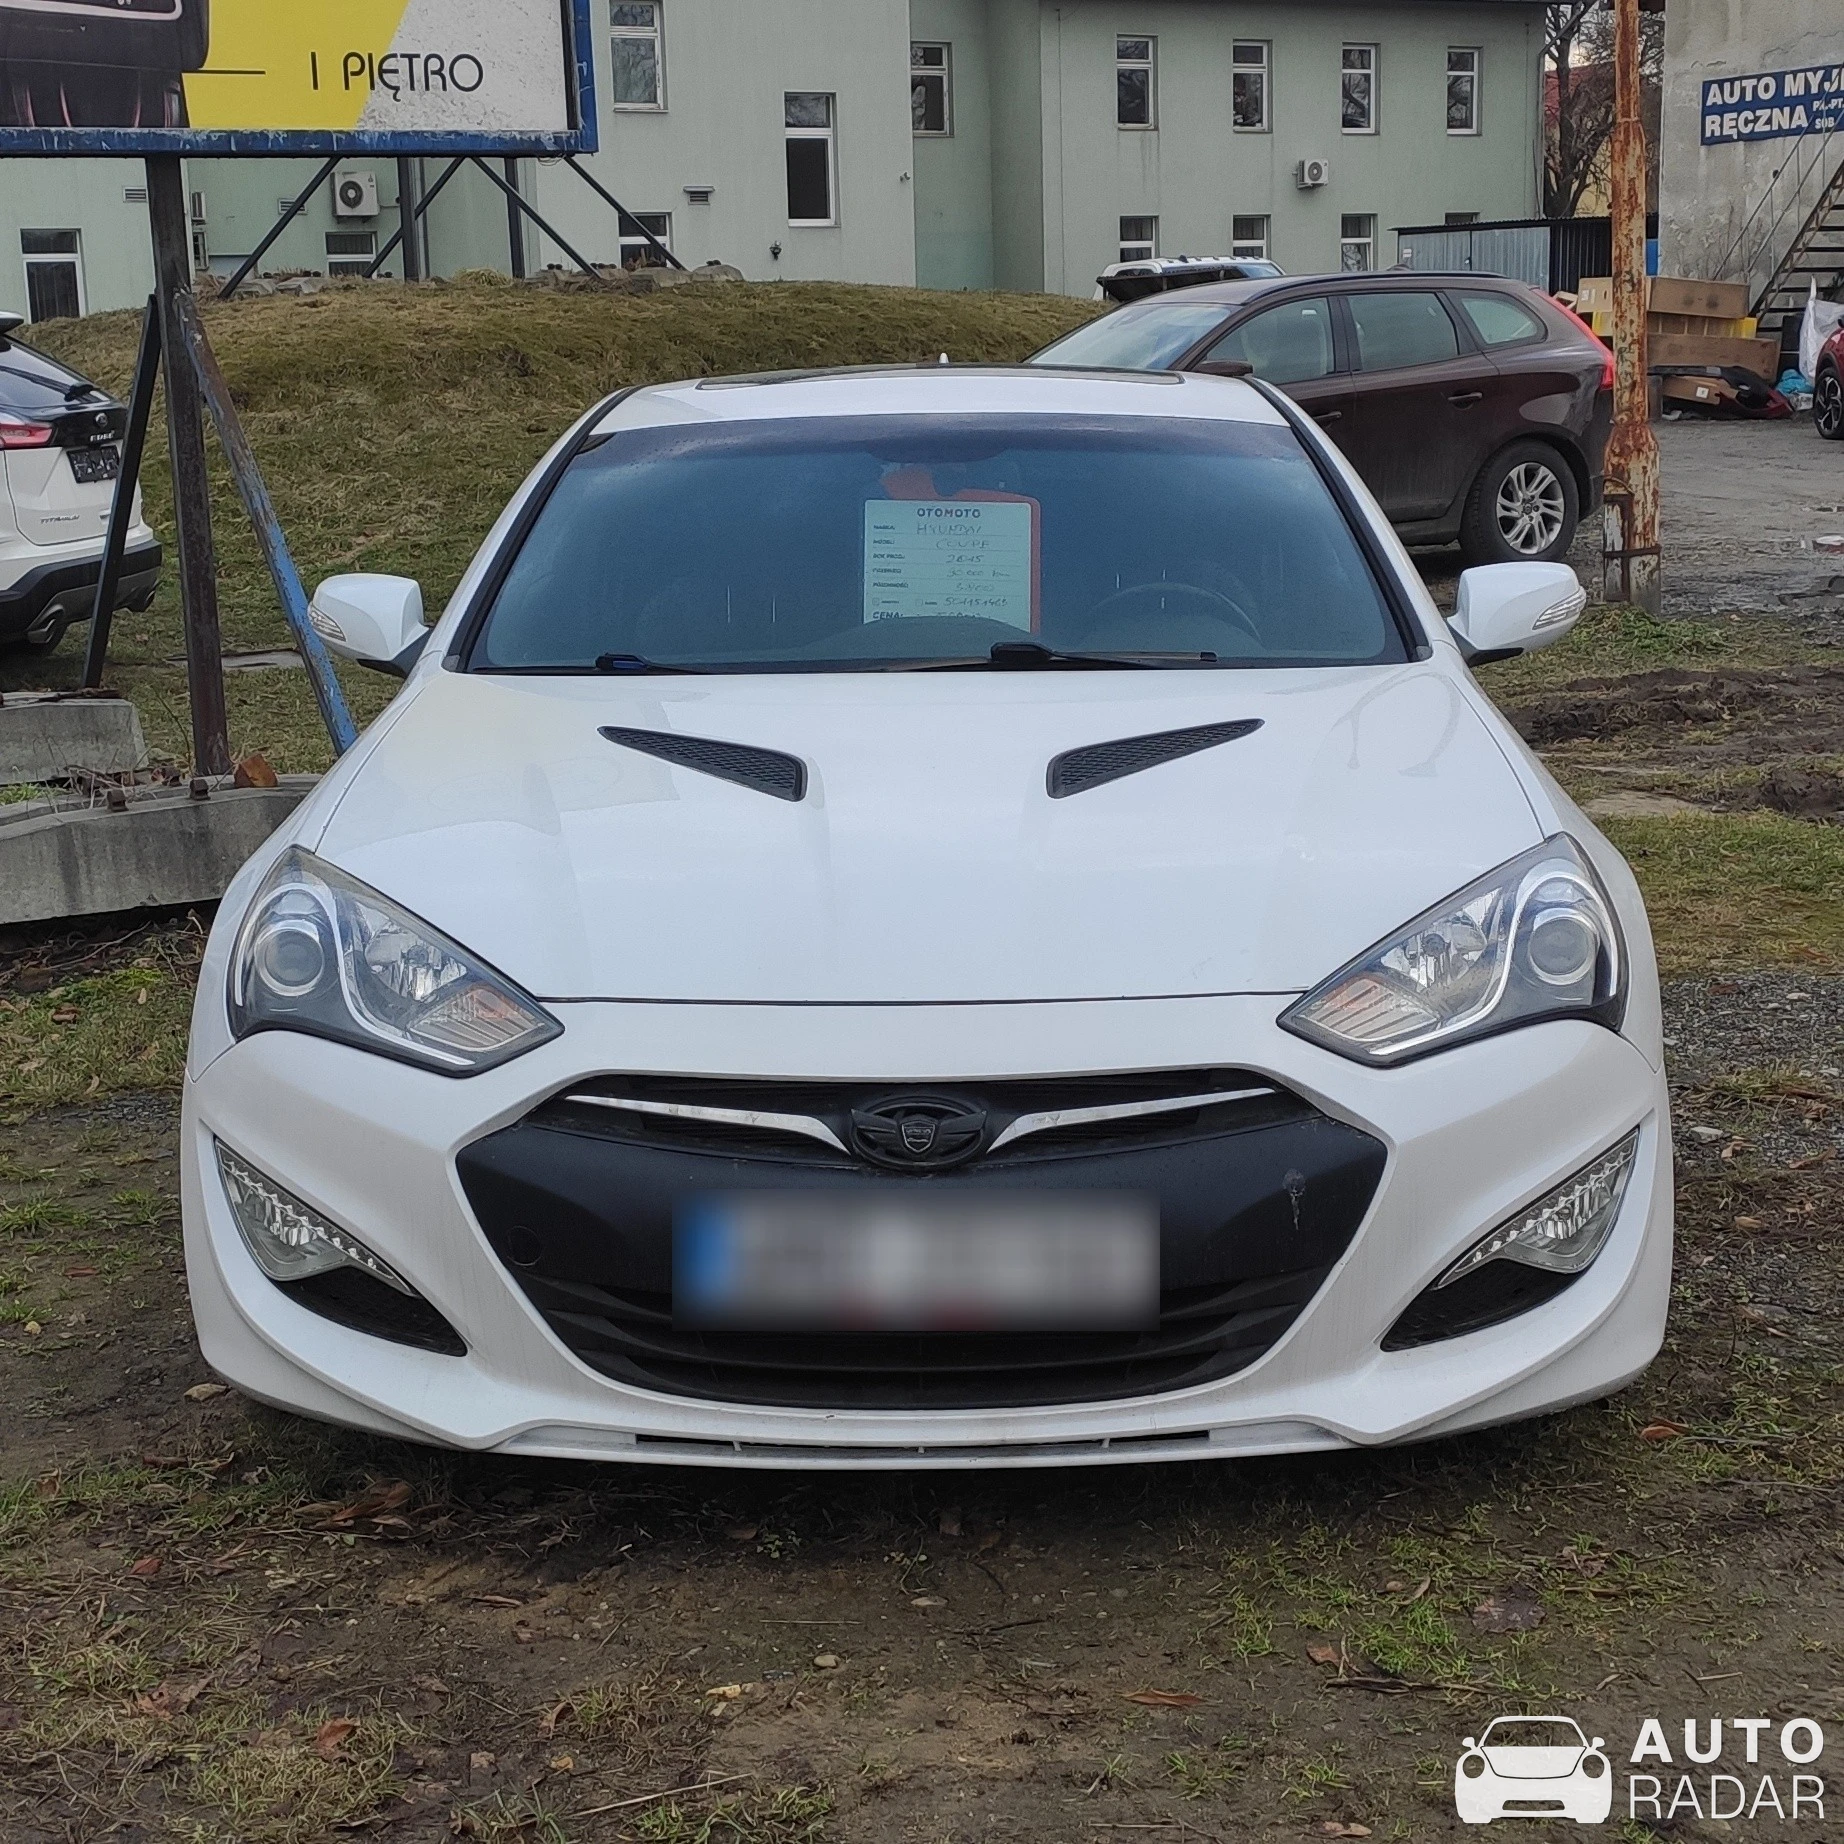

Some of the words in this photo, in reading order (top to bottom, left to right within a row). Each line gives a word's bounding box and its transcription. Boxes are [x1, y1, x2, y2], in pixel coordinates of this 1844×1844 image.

[343, 51, 485, 102] PIĘTRO
[1705, 76, 1777, 107] AUTO
[1783, 68, 1844, 97] MYJ
[1705, 105, 1809, 140] RĘCZNA
[917, 507, 982, 519] OTOMOTO
